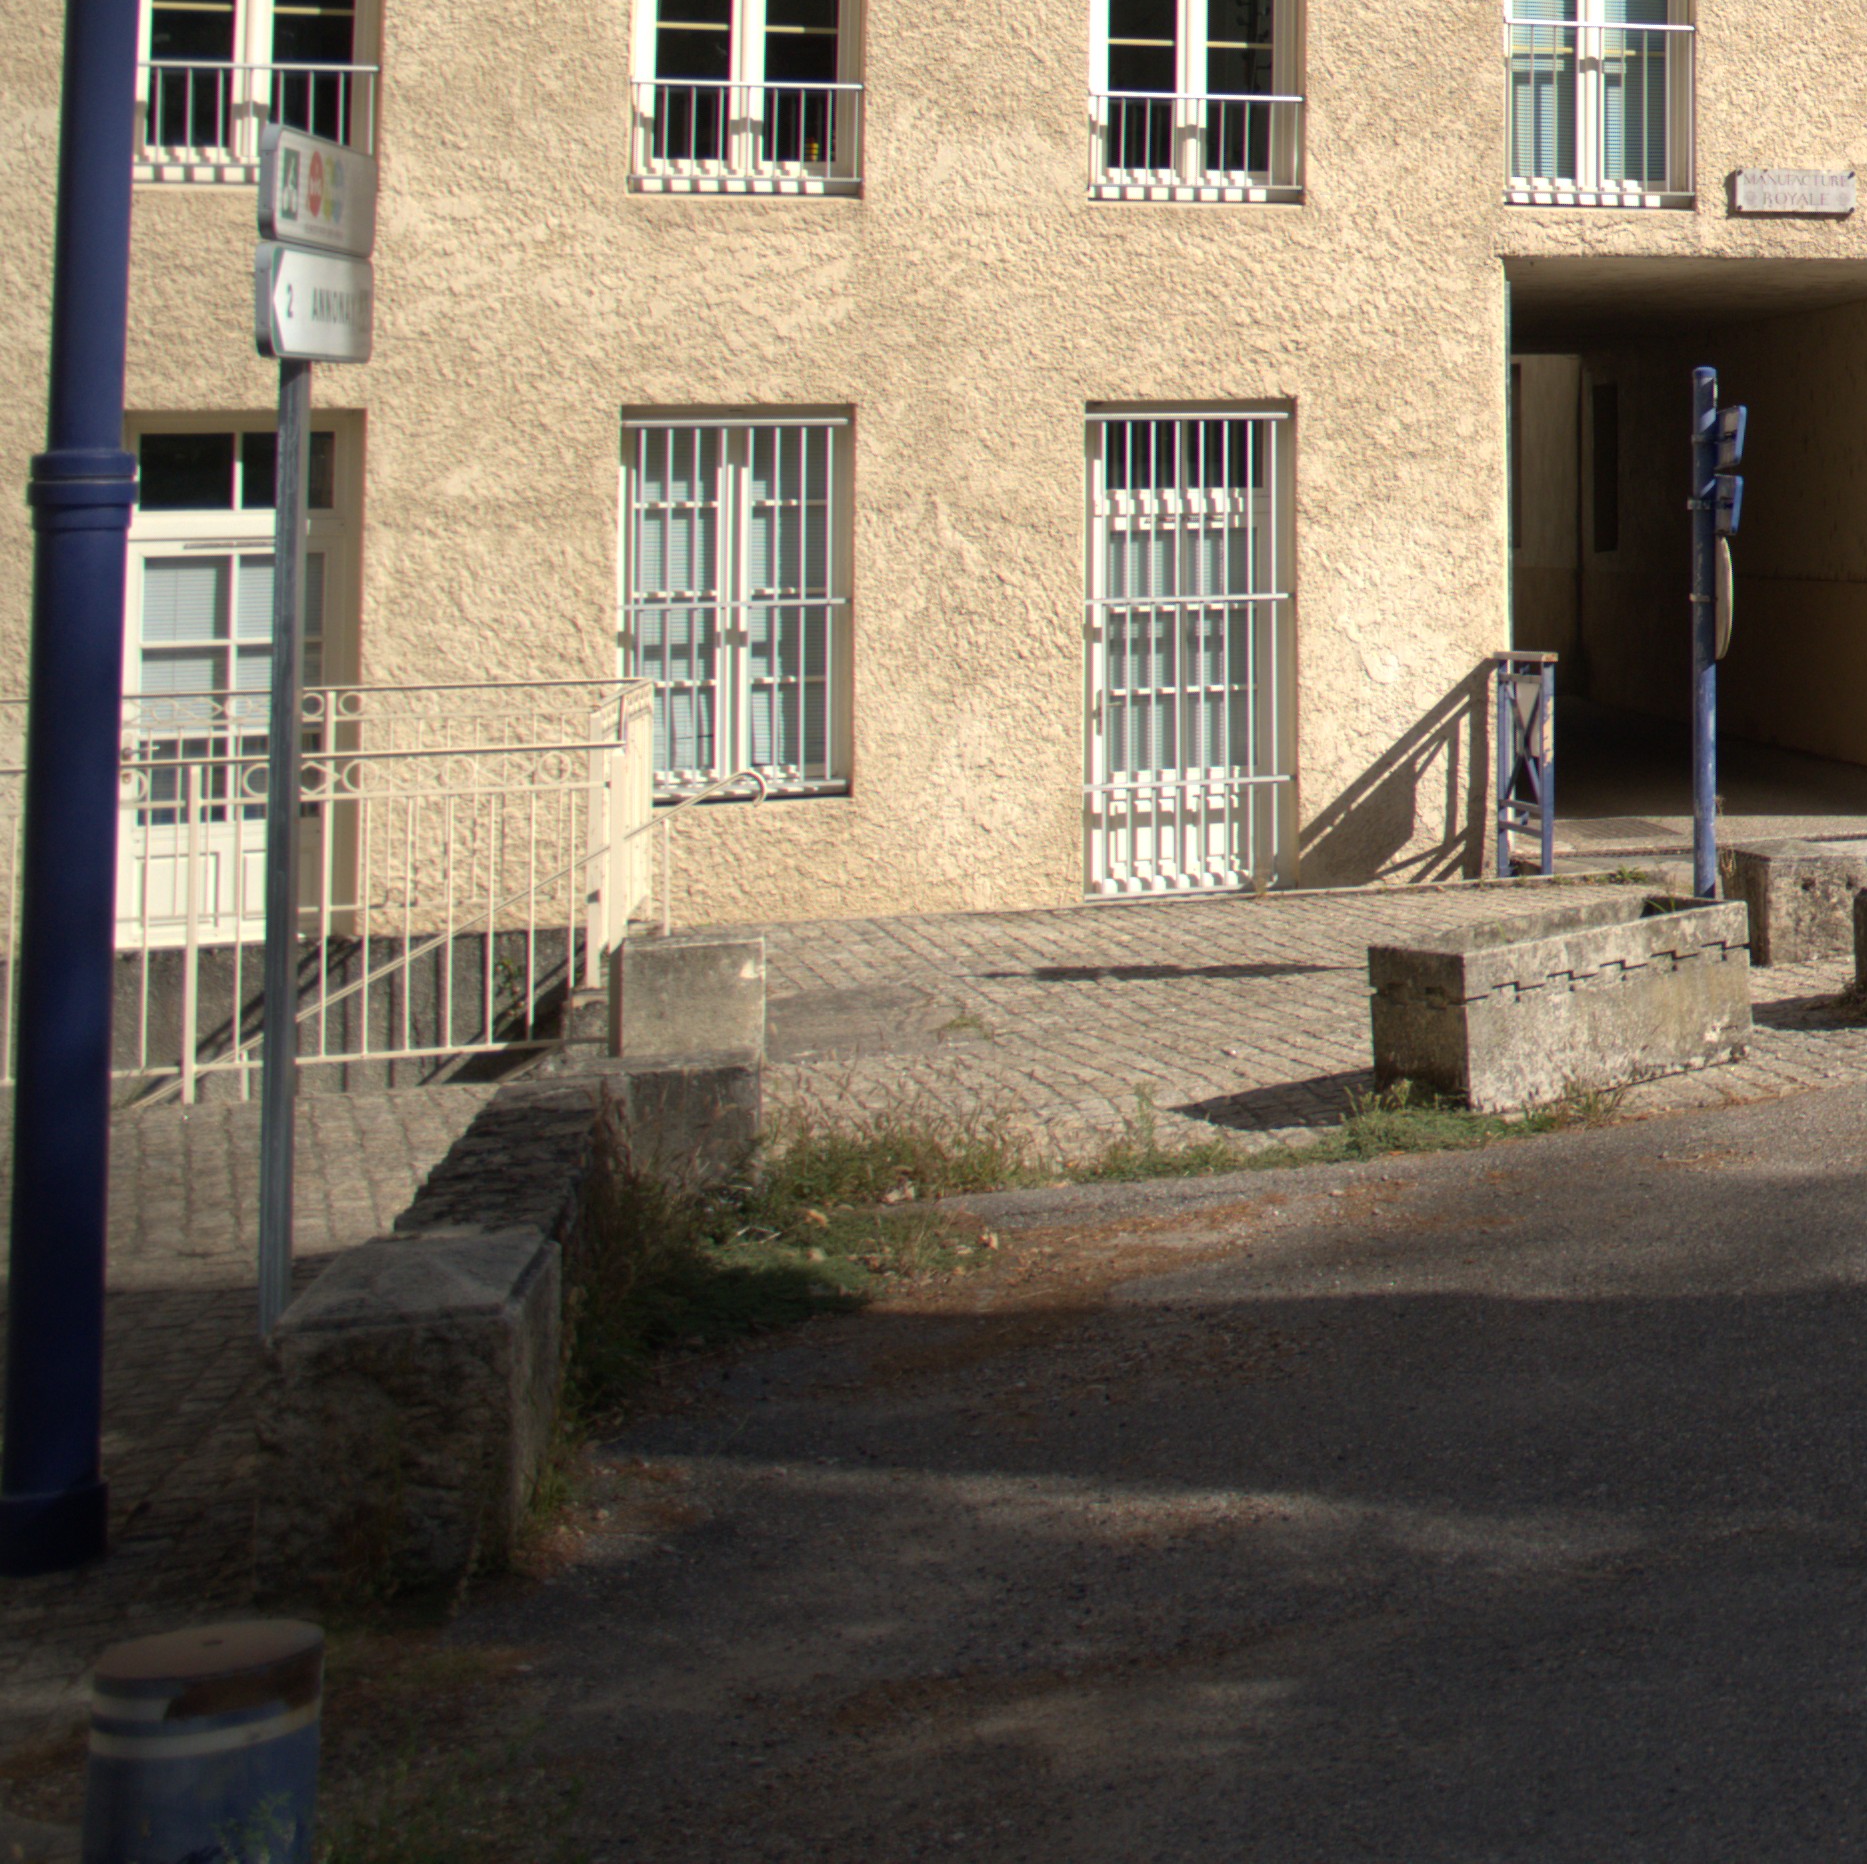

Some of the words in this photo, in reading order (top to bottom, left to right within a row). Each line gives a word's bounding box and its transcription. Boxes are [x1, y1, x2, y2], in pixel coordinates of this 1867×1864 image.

[1743, 173, 1849, 188] MANUFACTURE
[1762, 192, 1829, 207] ROYALE
[286, 284, 293, 318] 2
